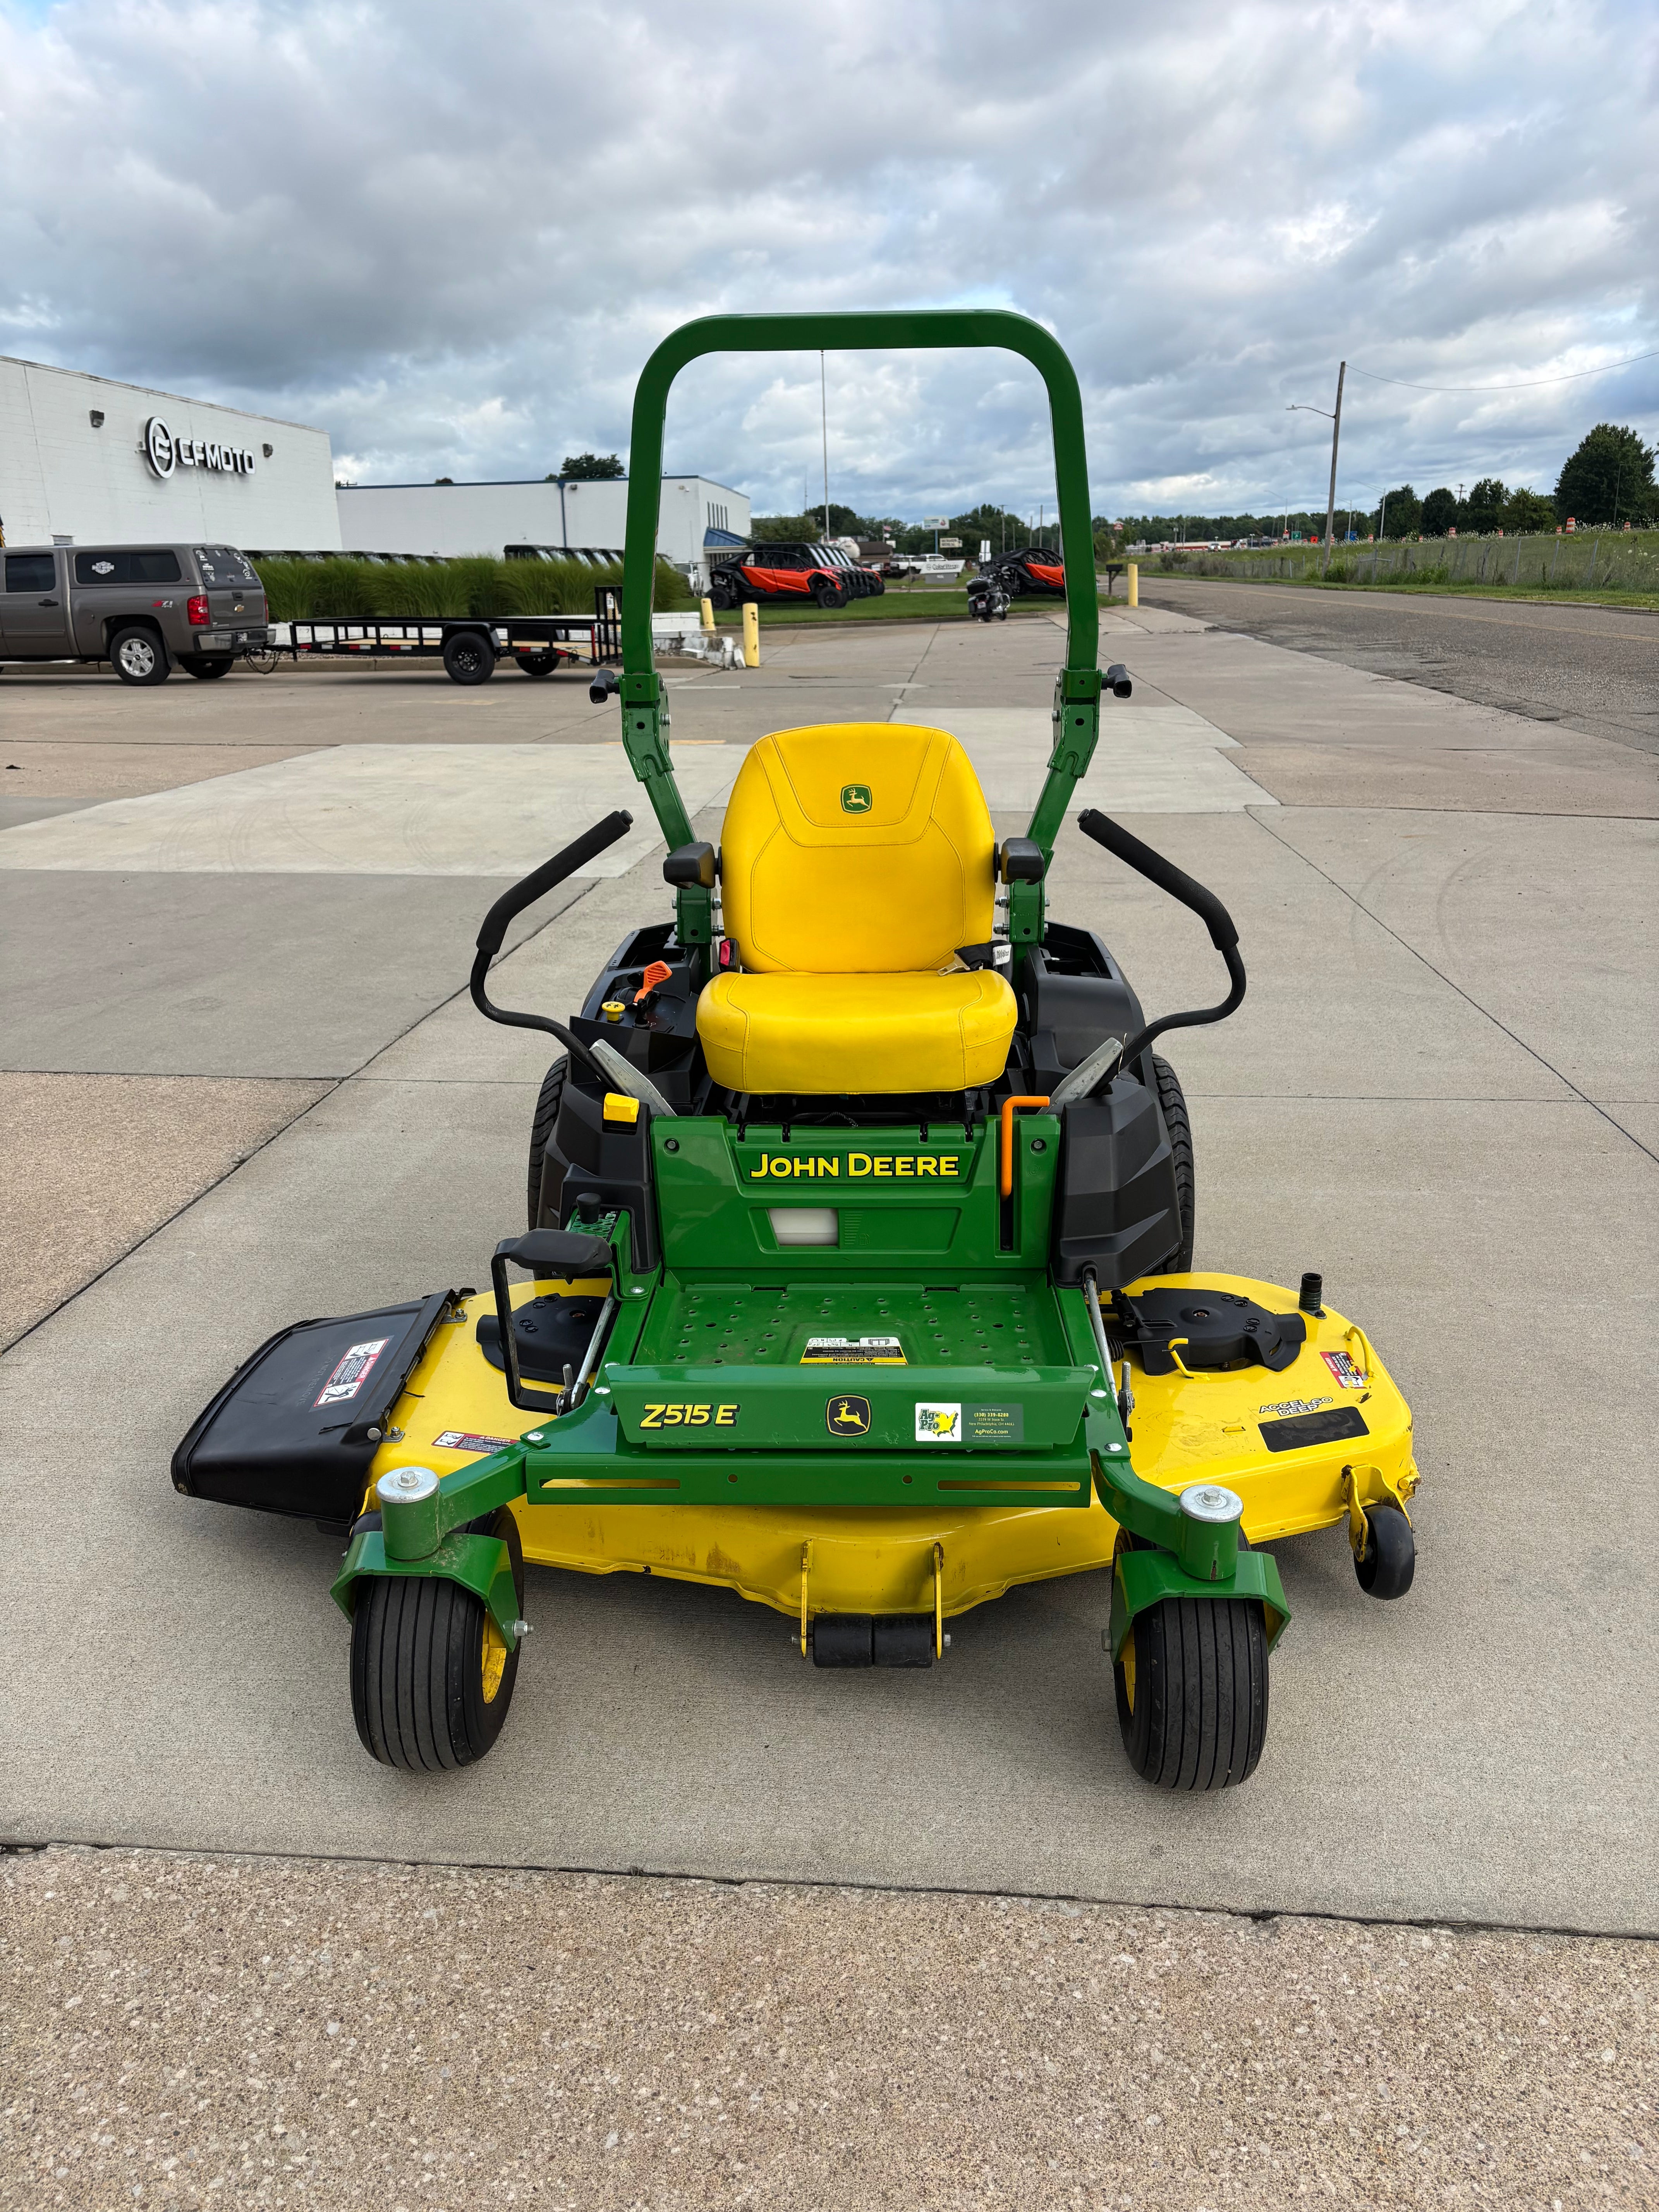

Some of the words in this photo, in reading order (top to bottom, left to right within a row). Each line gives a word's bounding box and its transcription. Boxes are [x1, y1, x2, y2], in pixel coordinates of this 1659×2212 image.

[176, 438, 255, 474] CFMOTO
[750, 1153, 840, 1177] JOHN
[847, 1152, 959, 1176] DEERE
[358, 1360, 374, 1378] DANGER
[1259, 1400, 1310, 1413] ACCEL
[1311, 1396, 1333, 1405] 60
[1278, 1404, 1318, 1416] DEEP
[639, 1404, 713, 1428] Z515
[715, 1404, 738, 1425] E
[920, 1410, 939, 1422] Ag-
[920, 1420, 939, 1429] Pro
